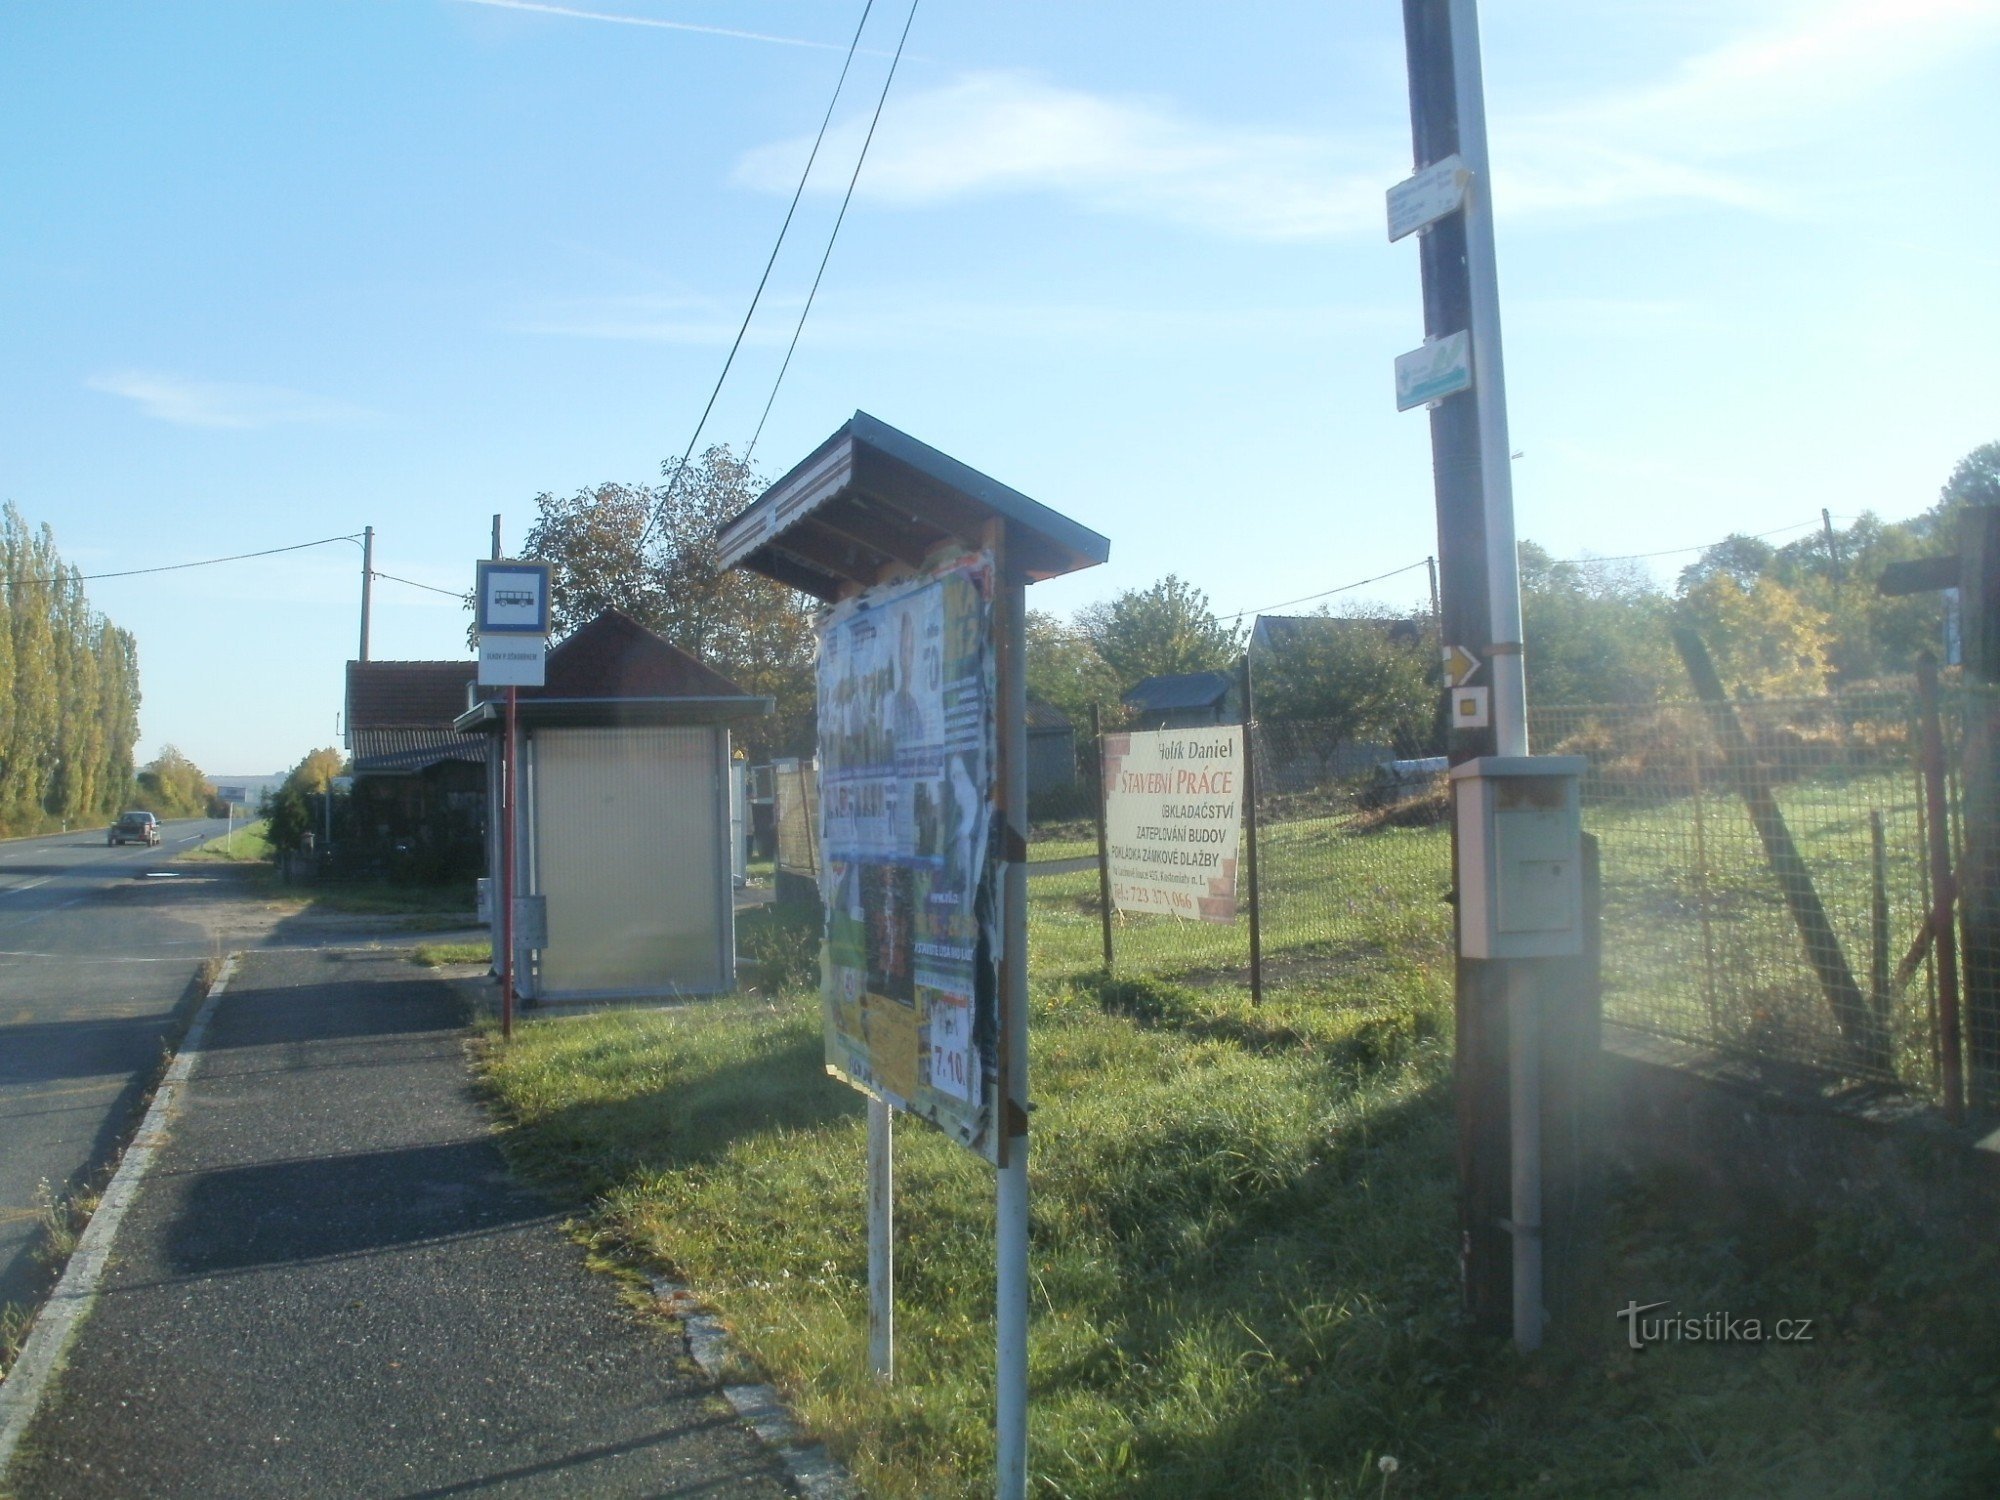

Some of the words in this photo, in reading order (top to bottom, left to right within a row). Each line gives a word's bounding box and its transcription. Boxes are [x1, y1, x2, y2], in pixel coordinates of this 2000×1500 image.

[1160, 741, 1184, 760] Holík
[1190, 738, 1232, 759] Daniel
[1122, 767, 1174, 794] STAVEBNÍ
[1178, 766, 1232, 795] PRÁCE
[1162, 801, 1234, 819] OBKLADAČSTVÍ
[1137, 825, 1186, 842] ZATEPLOVÁNÍ
[1189, 828, 1226, 844] BUDOV
[1142, 847, 1178, 865] ZÁMKOVÉ
[1180, 849, 1219, 867] DLAŽBY
[1131, 886, 1149, 904] 723
[1152, 888, 1170, 905] 371
[1172, 891, 1192, 909] 066
